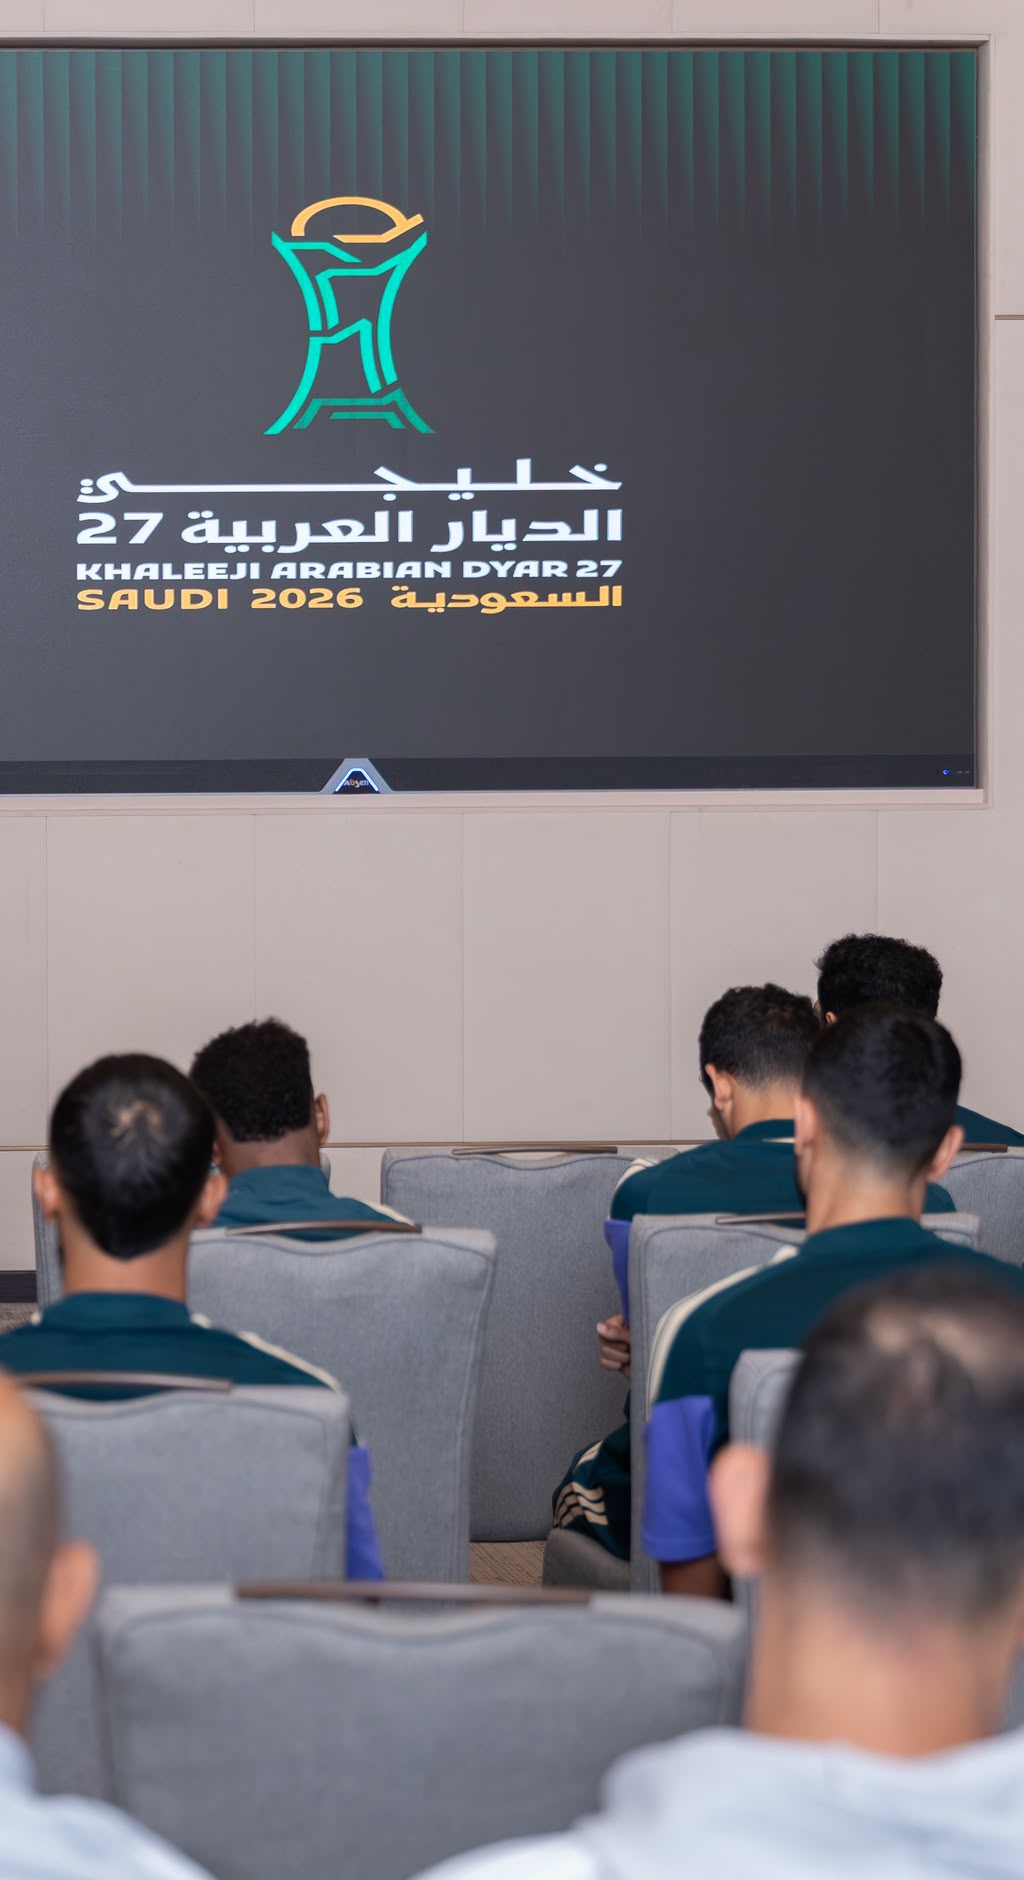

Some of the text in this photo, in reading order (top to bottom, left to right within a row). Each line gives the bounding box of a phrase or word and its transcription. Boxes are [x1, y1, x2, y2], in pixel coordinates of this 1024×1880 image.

[77, 458, 622, 503] خليجي
[77, 509, 622, 553] الديار العربية 27
[77, 560, 622, 580] KHALEEJI ARABIAN DYAR 27
[77, 588, 364, 610] SAUDI 2026
[391, 586, 623, 614] السعودية
